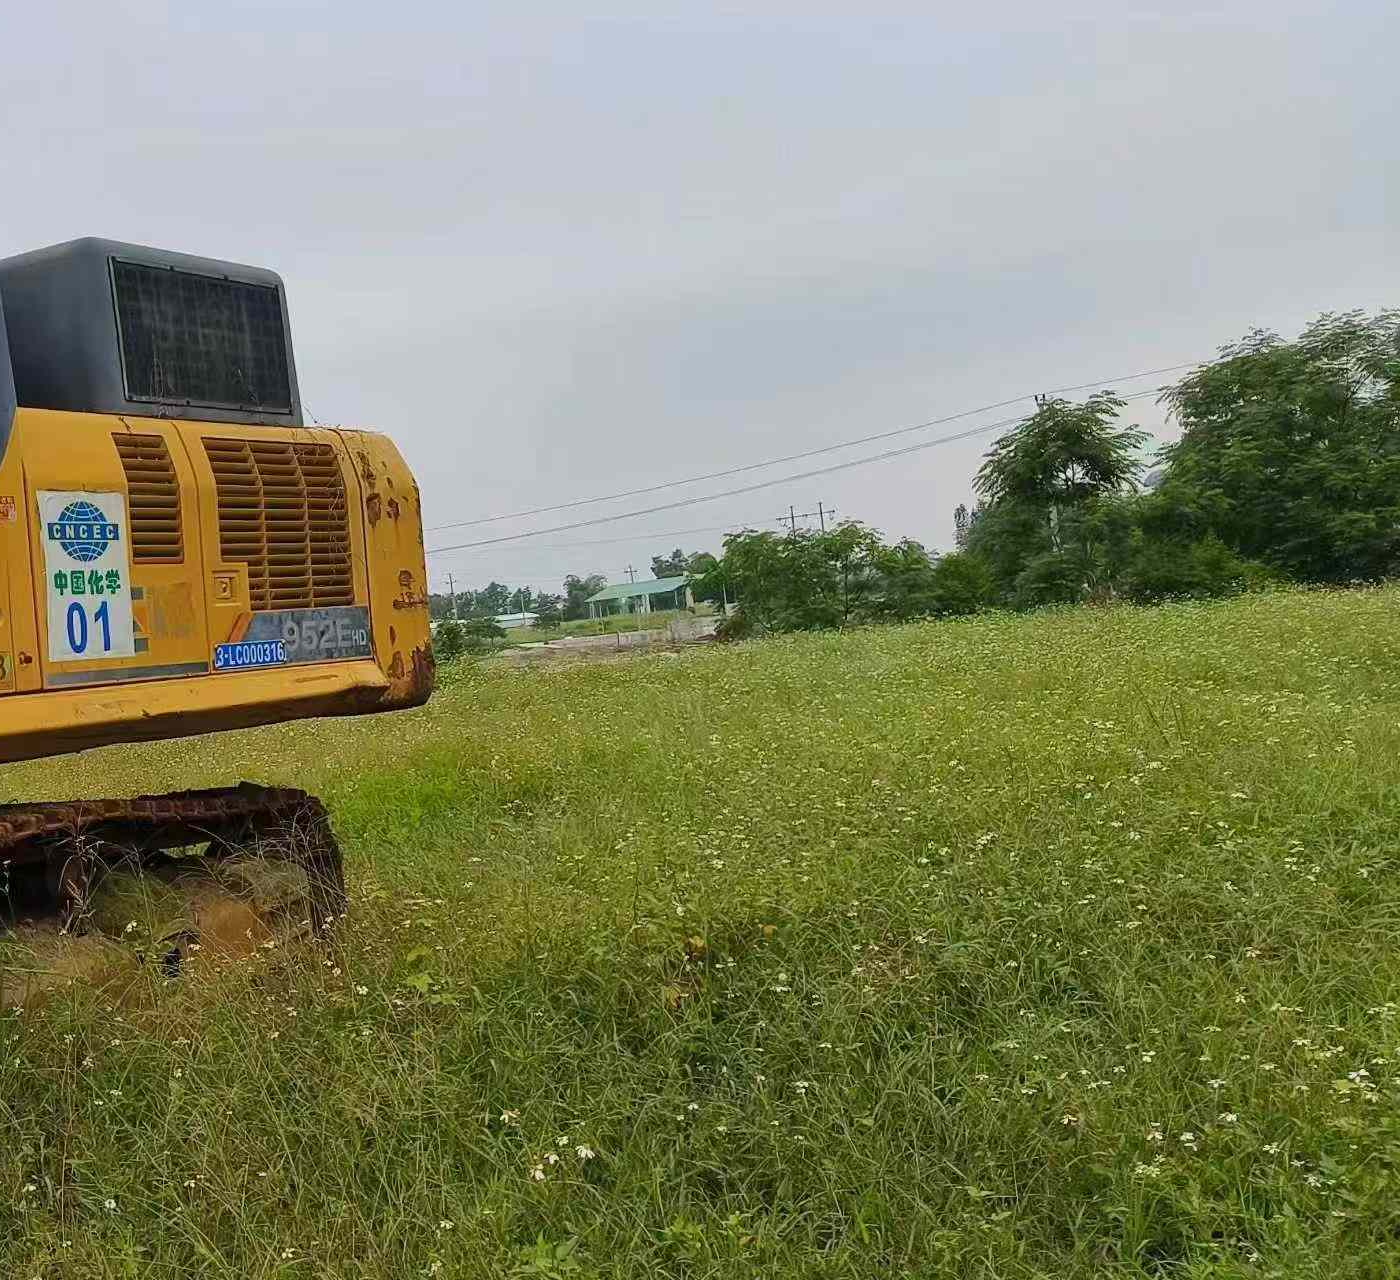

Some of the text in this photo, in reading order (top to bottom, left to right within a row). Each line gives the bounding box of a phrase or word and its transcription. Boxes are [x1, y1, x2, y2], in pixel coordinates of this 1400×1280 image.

[53, 524, 115, 540] CNCEC
[53, 569, 121, 596] 中国化学
[66, 600, 111, 654] 01
[215, 641, 286, 667] 3-LC000316
